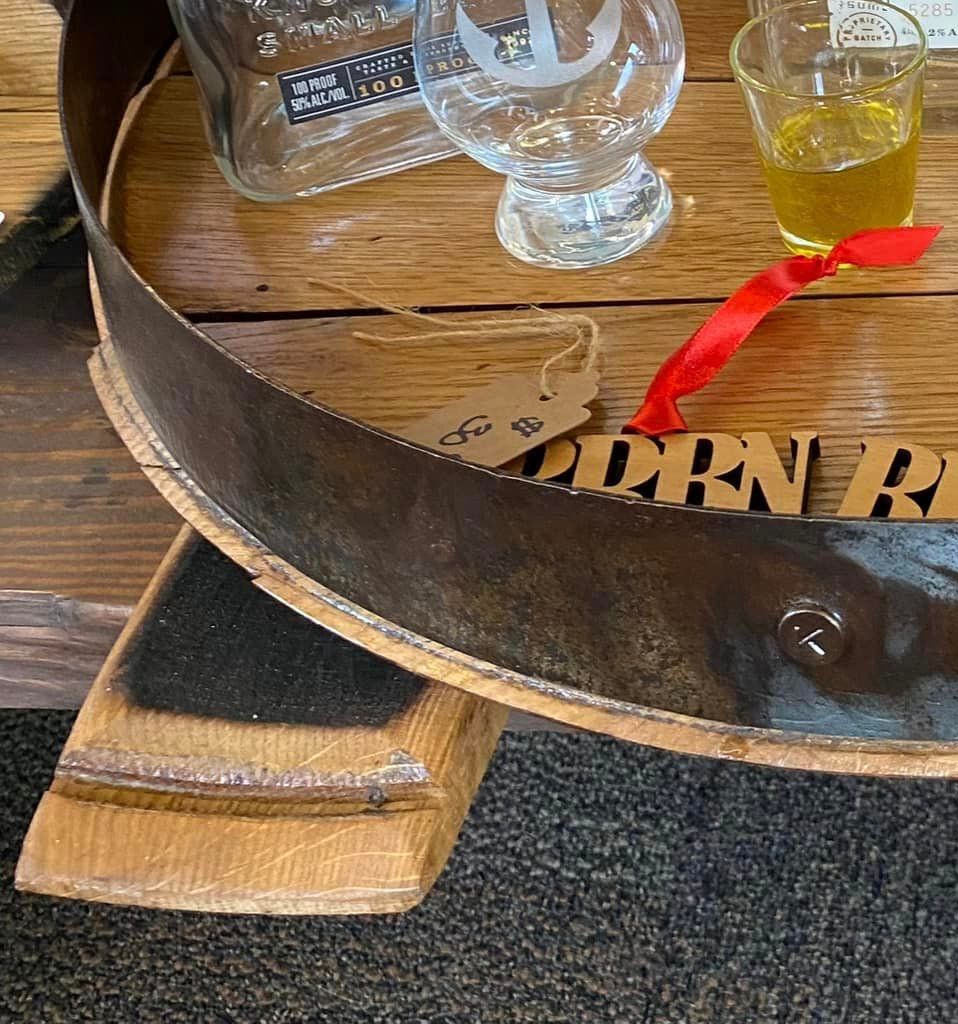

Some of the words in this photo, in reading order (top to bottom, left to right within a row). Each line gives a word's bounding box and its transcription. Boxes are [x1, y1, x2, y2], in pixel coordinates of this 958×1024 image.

[908, 2, 954, 17] 5285
[291, 80, 309, 96] 100
[310, 72, 338, 94] PROOF
[358, 75, 404, 98] 100
[425, 56, 476, 75] PRO
